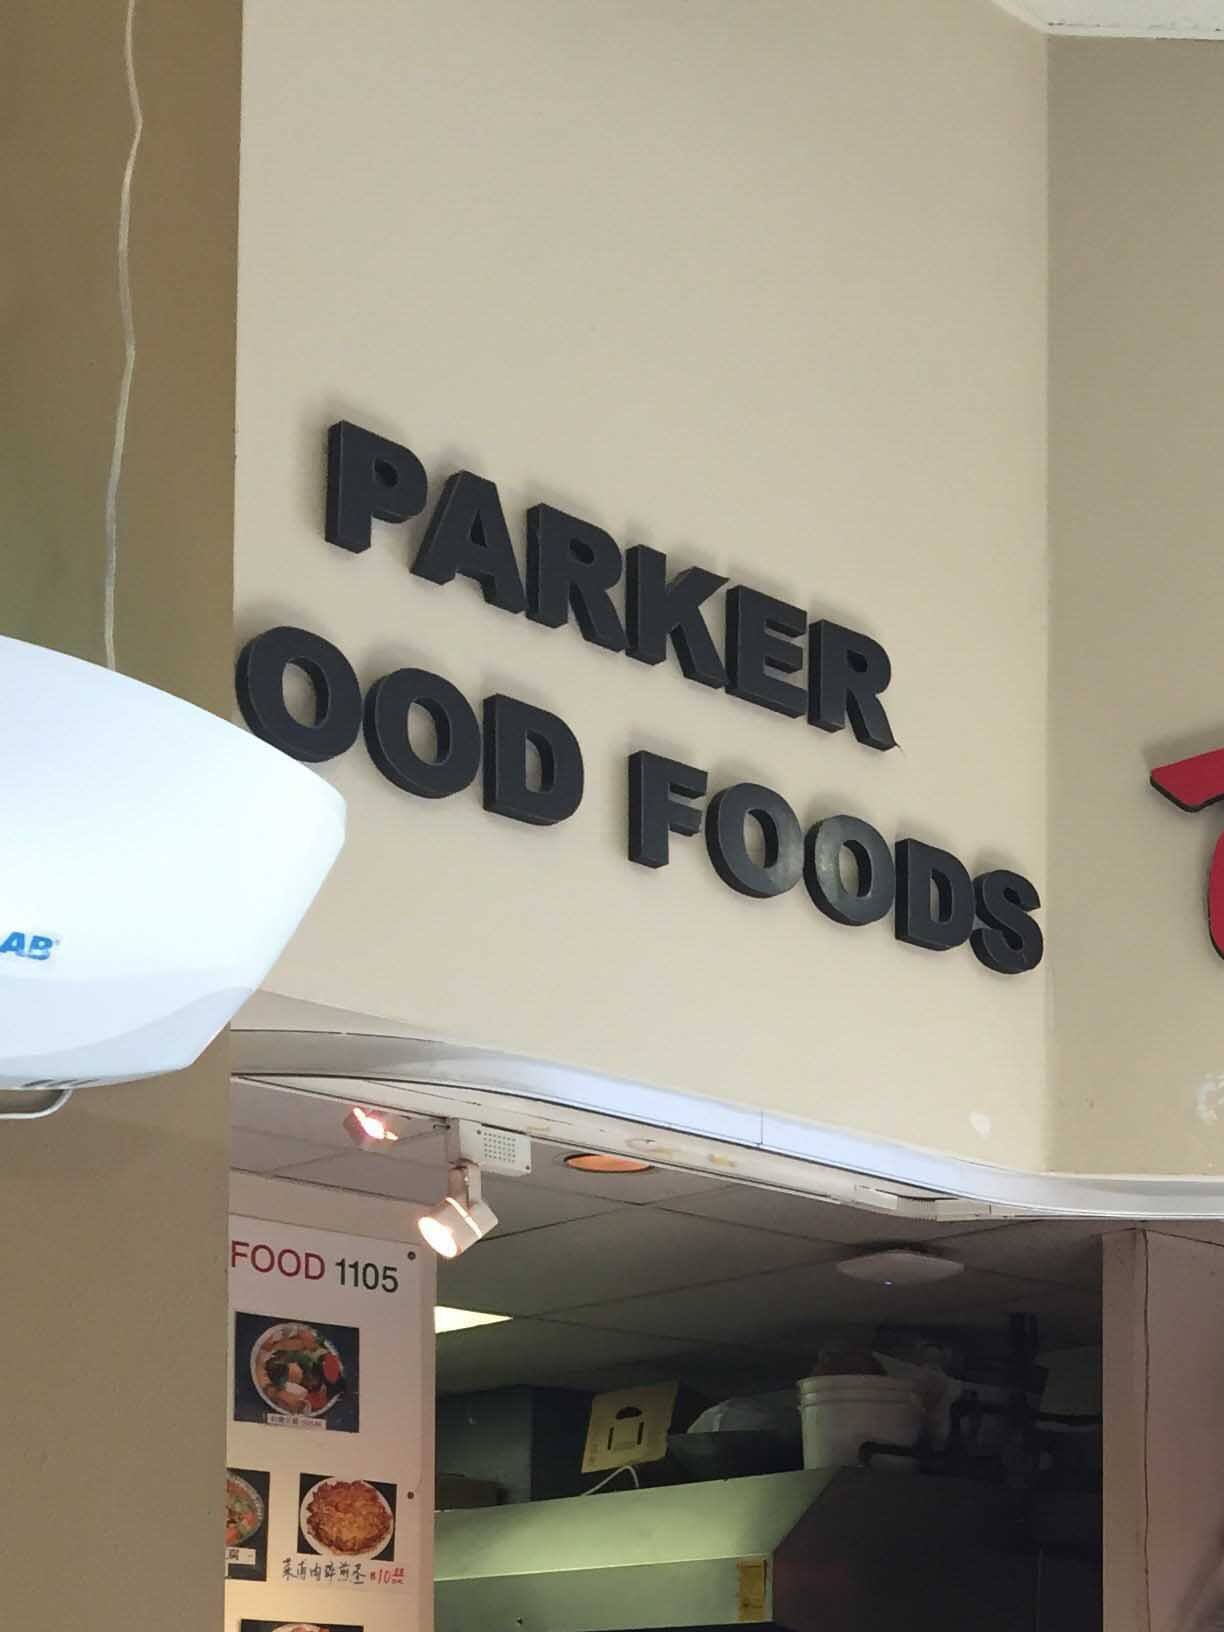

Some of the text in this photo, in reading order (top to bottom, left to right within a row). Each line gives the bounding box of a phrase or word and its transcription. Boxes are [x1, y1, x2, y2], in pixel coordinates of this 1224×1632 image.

[325, 420, 899, 751] PARKER
[234, 626, 1044, 975] OOD FOODS
[230, 1241, 400, 1294] FOOD 1105
